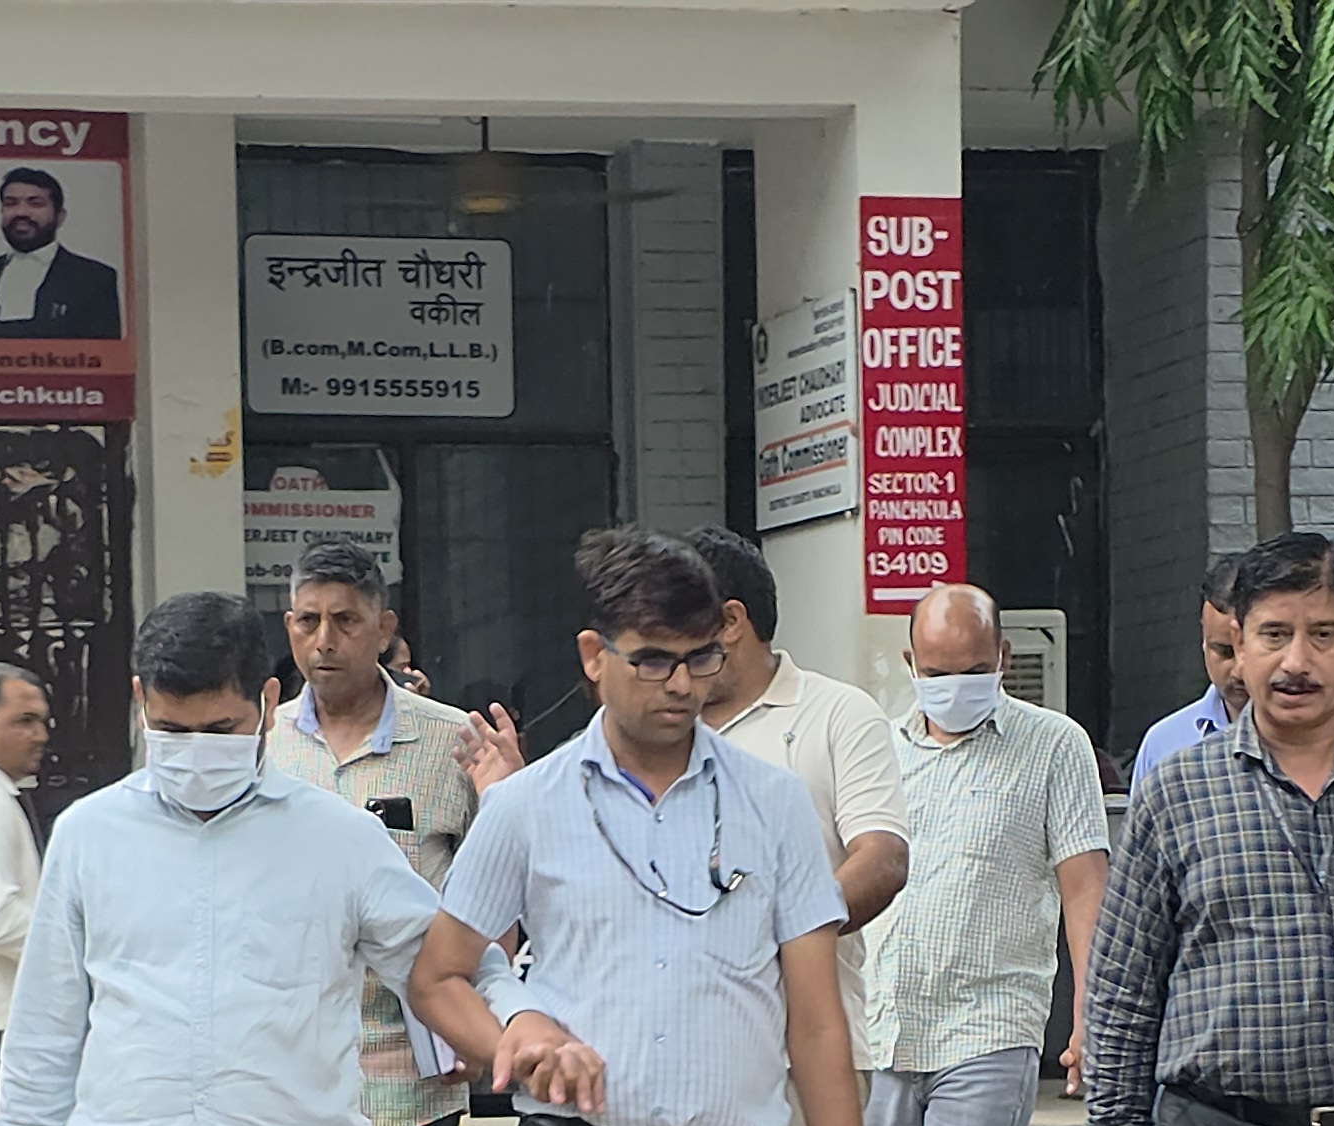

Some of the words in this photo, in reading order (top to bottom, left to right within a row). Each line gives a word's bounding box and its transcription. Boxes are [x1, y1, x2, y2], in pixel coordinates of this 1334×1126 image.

[867, 215, 950, 257] SUB-
[266, 248, 386, 291] इन्द्रजीत
[863, 270, 961, 311] POST
[409, 293, 484, 325] वकील
[863, 326, 962, 369] OFFICE
[327, 379, 480, 398] 9915555915
[869, 382, 963, 413] JUDICIAL
[875, 426, 963, 458] COMPLEX
[868, 471, 956, 494] SECTOR-1
[244, 502, 375, 518] MMISSIONER
[868, 500, 963, 521] PANCHKULA
[877, 526, 903, 545] PIN
[905, 526, 945, 545] CODE
[868, 551, 949, 577] 134109
